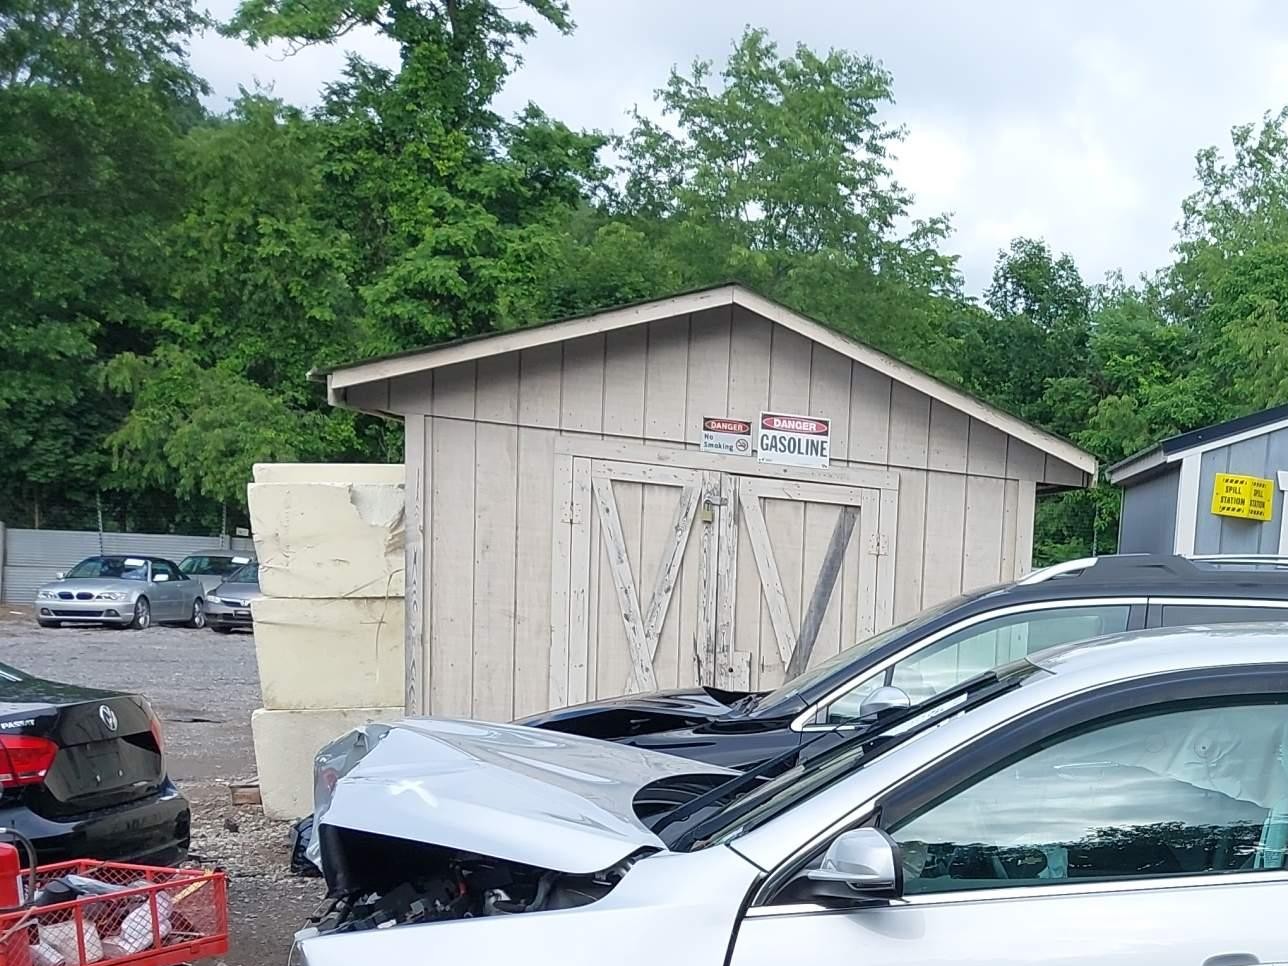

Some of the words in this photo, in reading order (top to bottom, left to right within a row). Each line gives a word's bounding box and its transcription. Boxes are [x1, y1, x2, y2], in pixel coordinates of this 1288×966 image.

[711, 421, 743, 432] DANGER
[773, 417, 817, 432] DANGER
[704, 441, 734, 452] Smoking
[760, 434, 828, 458] GASOLINE
[1225, 486, 1241, 494] SPILL
[1220, 496, 1245, 505] STATION
